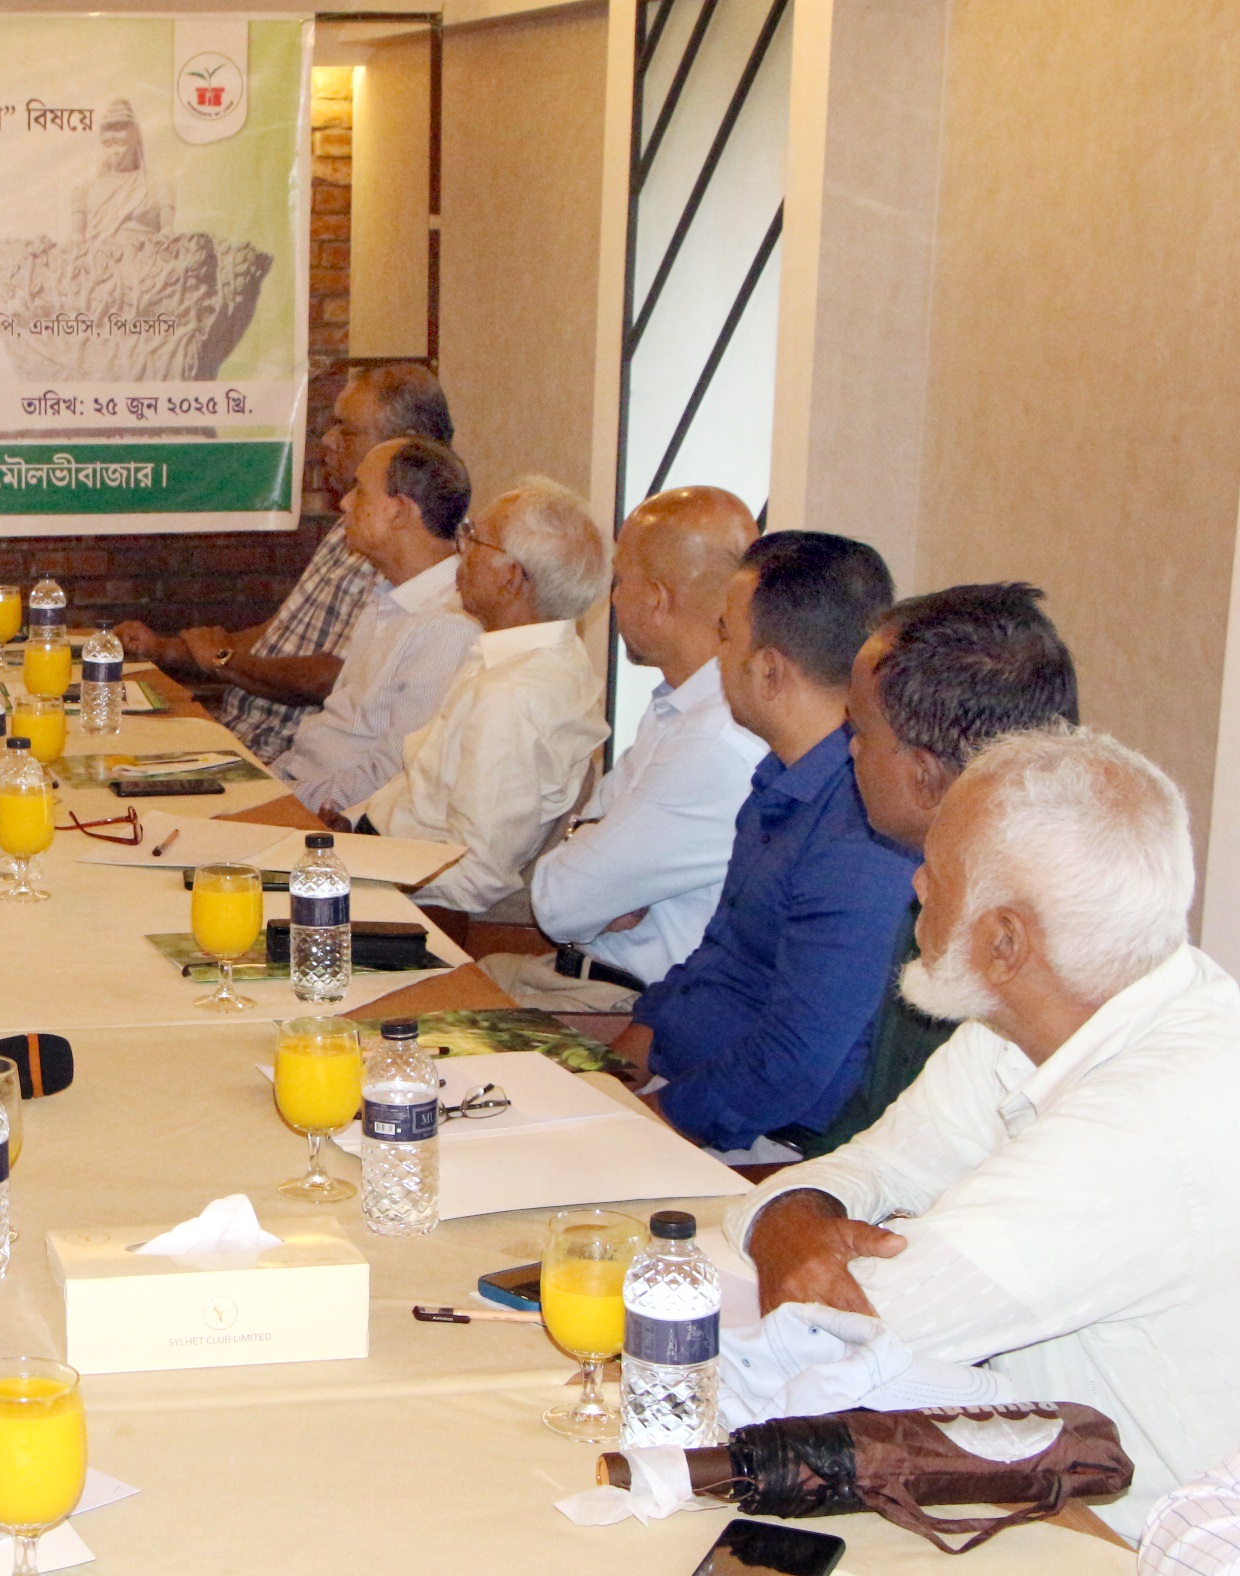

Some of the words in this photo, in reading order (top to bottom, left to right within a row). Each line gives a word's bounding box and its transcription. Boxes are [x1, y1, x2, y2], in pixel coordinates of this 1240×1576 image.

[25, 99, 95, 132] বিষয়ে
[28, 312, 101, 340] এনডিসি,
[108, 312, 177, 337] পিএসসি
[21, 390, 85, 417] তারিখ:
[92, 397, 118, 416] ২৫
[126, 396, 159, 421] জুন
[166, 397, 218, 417] ২০২৫
[168, 1336, 204, 1347] SYLHET
[206, 1335, 231, 1345] CLUB
[233, 1332, 272, 1343] LIMITED
